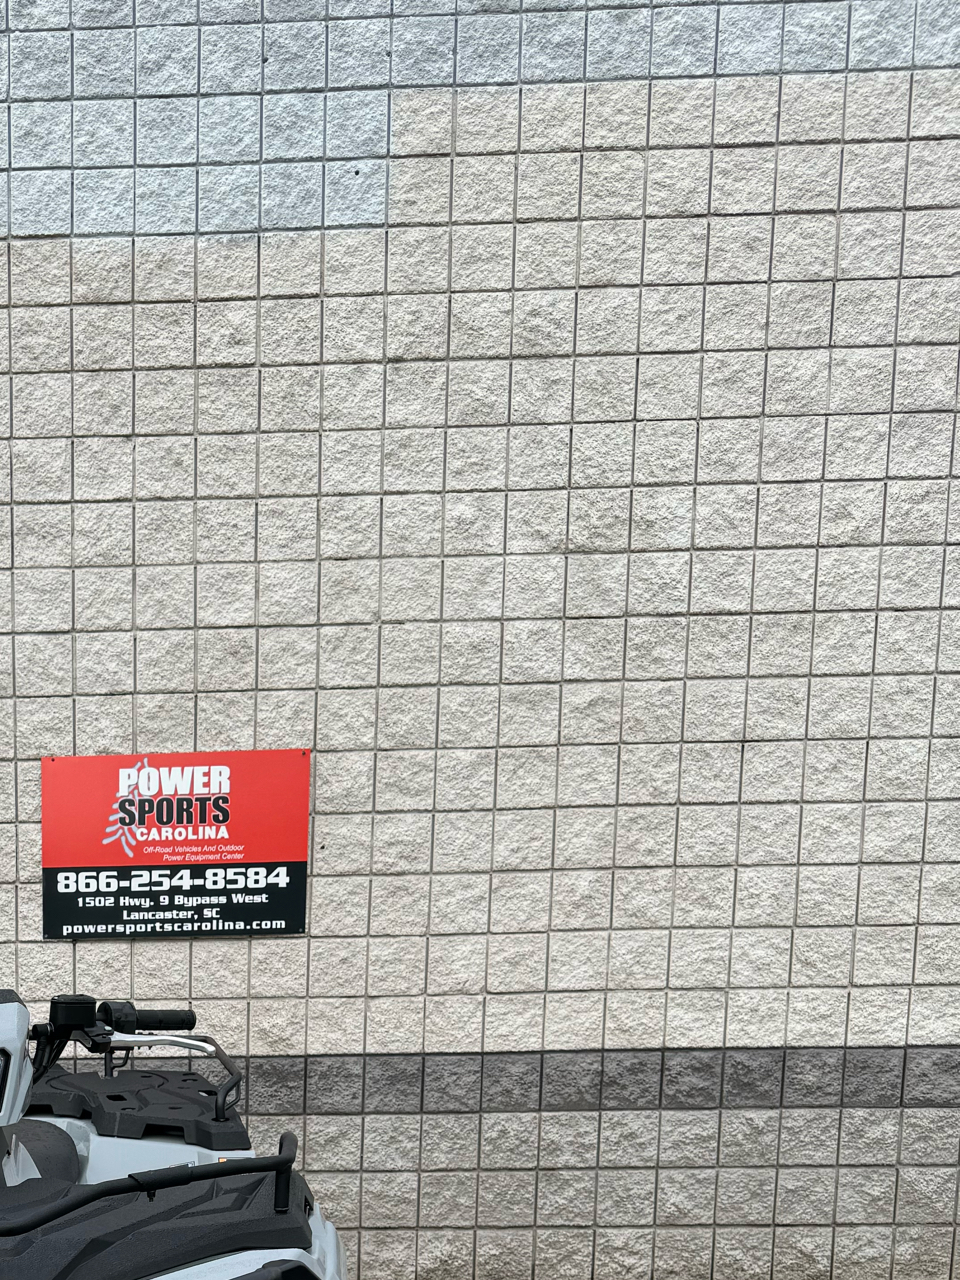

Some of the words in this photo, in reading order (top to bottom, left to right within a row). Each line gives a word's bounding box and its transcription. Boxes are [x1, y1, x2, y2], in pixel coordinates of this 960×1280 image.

[119, 766, 230, 796] POWER
[118, 796, 230, 826] SPORTS
[136, 826, 229, 841] CAROLINA
[185, 853, 220, 861] Equipment
[57, 867, 290, 893] 866-254-8584
[77, 897, 115, 907] 1502
[120, 896, 154, 908] Hwy.
[160, 895, 169, 905] 9
[174, 895, 227, 907] Bypass
[231, 893, 269, 903] West
[123, 910, 198, 920] Lancaster,
[203, 908, 220, 918] SC
[62, 919, 286, 936] powersportscarolina.com
